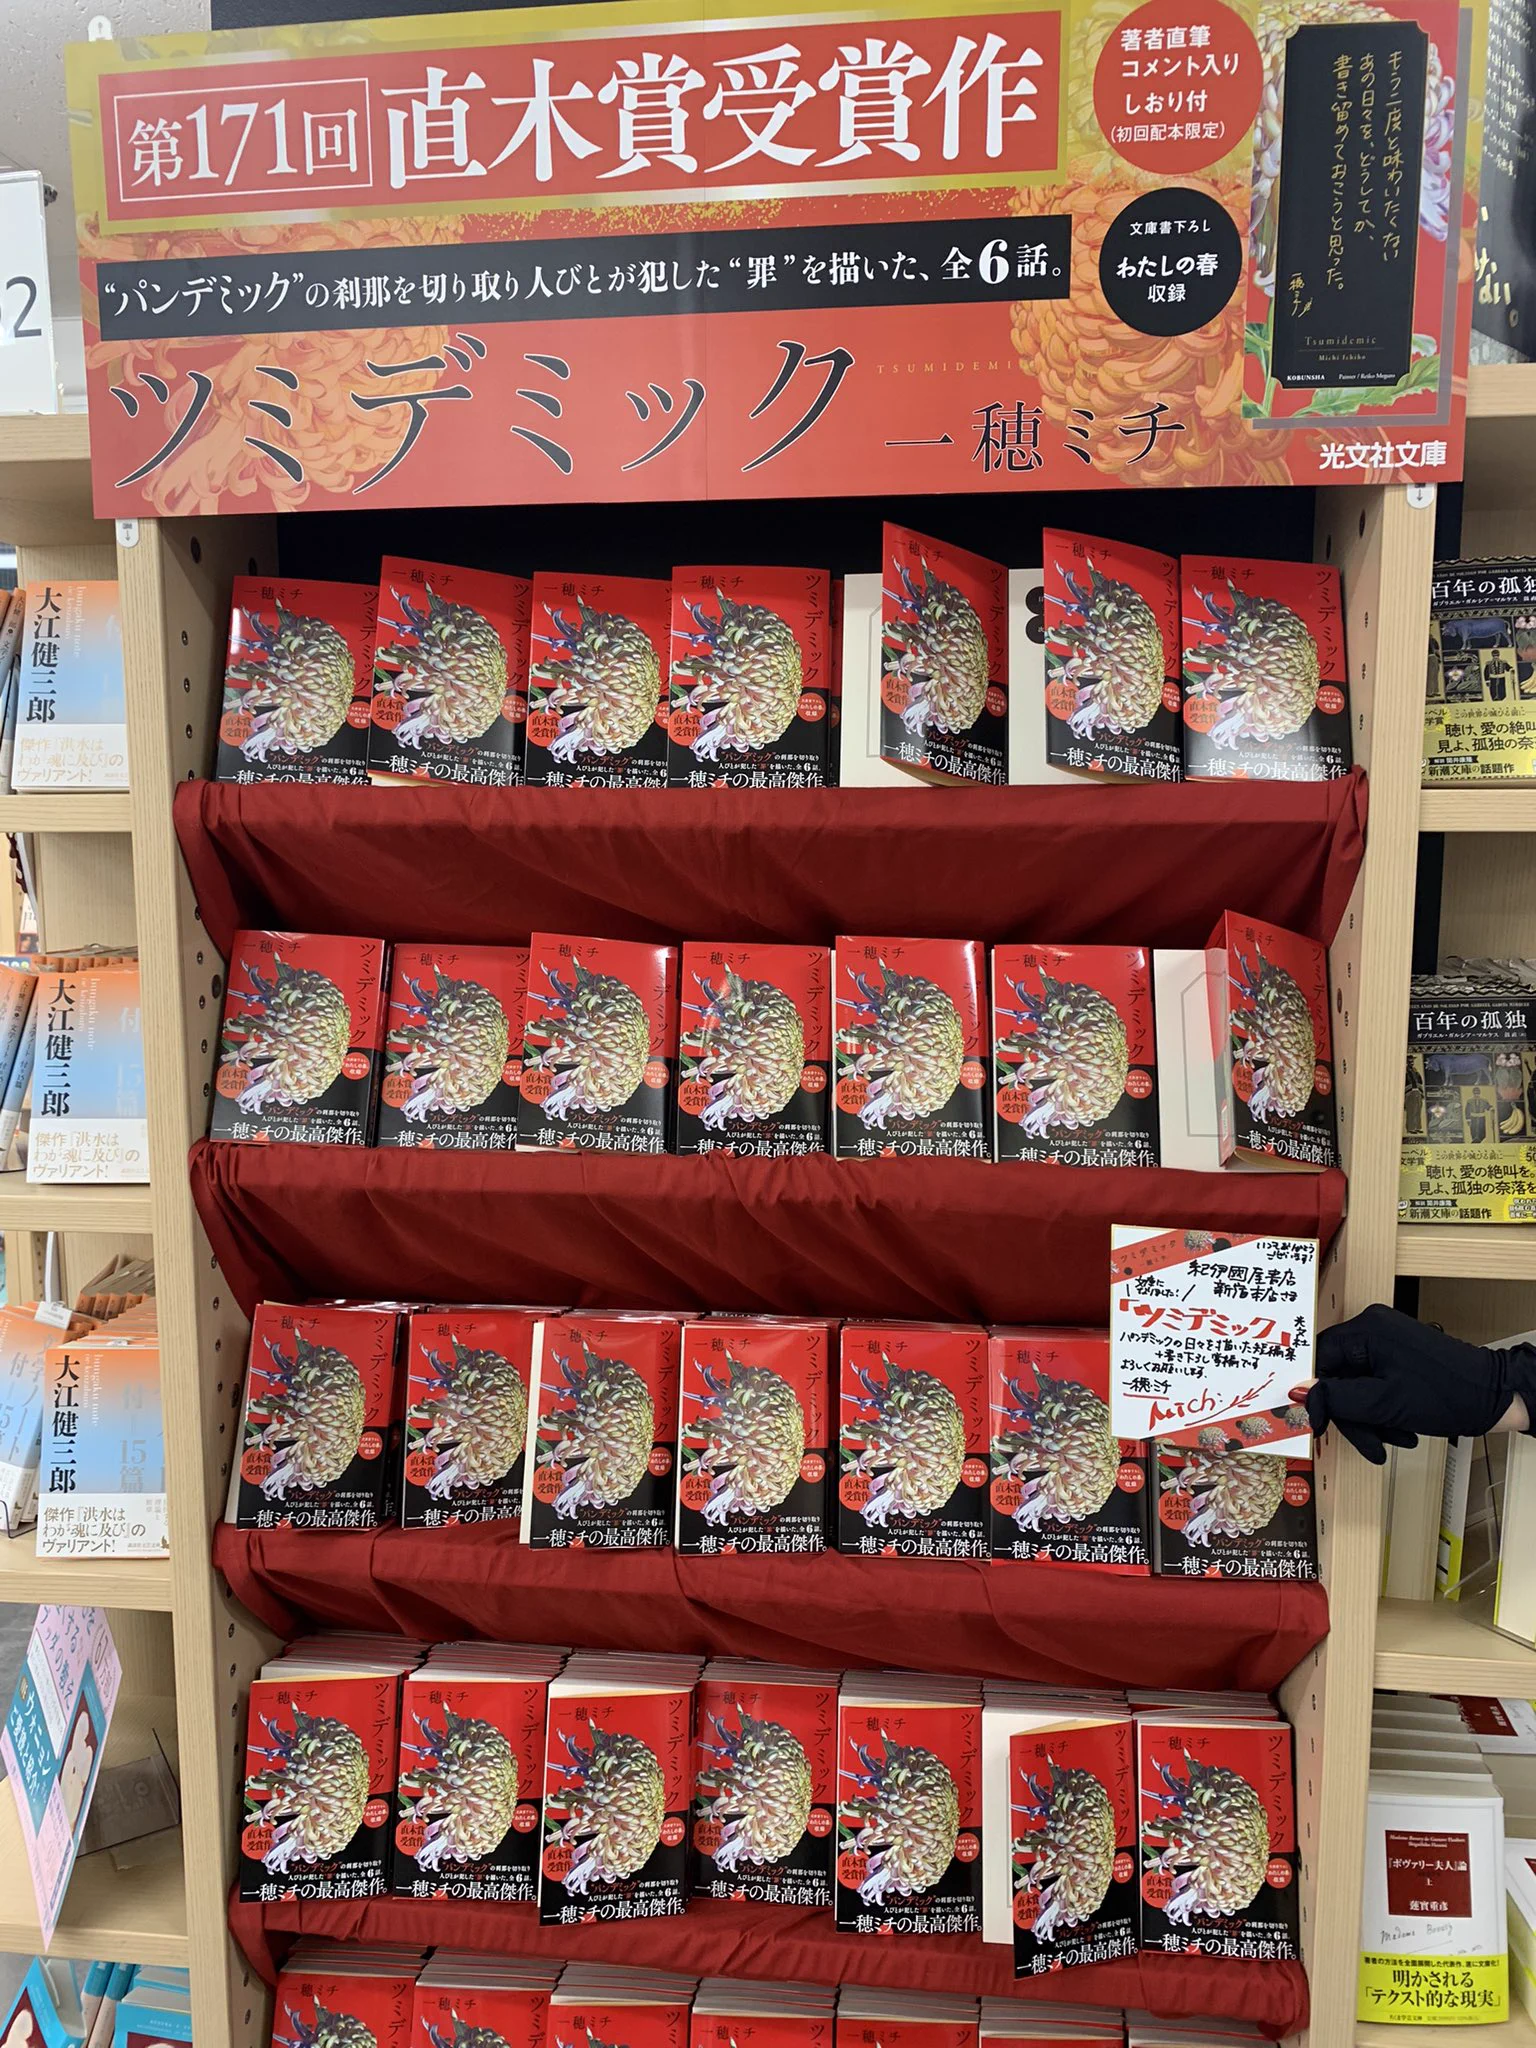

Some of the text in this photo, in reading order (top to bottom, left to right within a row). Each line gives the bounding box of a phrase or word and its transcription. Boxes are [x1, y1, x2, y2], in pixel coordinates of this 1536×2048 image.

[1120, 26, 1211, 51] 著者直筆
[1121, 53, 1240, 79] コメント入り
[380, 31, 1044, 189] 直木賞受賞作
[1124, 91, 1208, 115] しおり付
[1109, 120, 1227, 143] (初回配本限定)
[127, 99, 358, 189] 第171回
[1129, 218, 1212, 236] 文庫書下ろし
[1116, 253, 1219, 279] わたしの春
[1147, 284, 1186, 305] 収録
[1304, 336, 1377, 346] Tsumidemic
[877, 361, 1026, 374] TSUMIDEMI
[109, 333, 855, 494] ツミデミック
[885, 401, 1186, 473] 一穂ミチ
[1319, 441, 1448, 469] 光文社文庫
[684, 575, 743, 587] 一穂ミチ
[1193, 565, 1254, 579] 一穂ミチ
[544, 582, 603, 596] 一穂ミチ
[804, 575, 822, 683] ツミデミック
[1315, 571, 1335, 676] ツミデミック
[26, 587, 63, 724] 大江健三郎
[1437, 736, 1536, 754] 見よ、孤独の奈
[243, 941, 301, 954] 一穂ミチ
[542, 944, 598, 957] 一穂ミチ
[847, 946, 904, 959] 一穂ミチ
[1005, 954, 1065, 967] 一穂ミチ
[351, 943, 376, 1044] ツミデミック
[1413, 1010, 1527, 1031] 百年の孤独
[41, 978, 77, 1117] 大江健三郎
[213, 1123, 365, 1145] 一穂ミチの最高傑作。
[840, 1139, 992, 1158] 一穂ミチの最高傑作。
[265, 1316, 320, 1329] 一穂ミチ
[421, 1324, 476, 1336] 一穂ミチ
[850, 1340, 908, 1353] 一穂ミチ
[366, 1318, 390, 1423] ツミデミック
[656, 1330, 675, 1439] ツミデミック
[806, 1336, 823, 1445] ツミデミック
[965, 1340, 982, 1449] ツミデミック
[48, 1355, 80, 1494] 大江健三郎
[42, 1538, 116, 1554] ヴァリアント!
[533, 1528, 670, 1547] 一穂ミチの最高傑作。
[682, 1534, 827, 1553] 一穂ミチの最高傑作。
[842, 1537, 991, 1558] 一穂ミチの最高傑作。
[995, 1543, 1149, 1565] 一穂ミチの最高傑作。
[1164, 1556, 1317, 1579] 一穂ミチの最高傑作。
[559, 1707, 614, 1720] 一穂ミチ
[850, 1717, 906, 1731] 一穂ミチ
[371, 1683, 390, 1790] ツミデミック
[519, 1688, 539, 1793] ツミデミック
[813, 1692, 831, 1798] ツミデミック
[1152, 1736, 1209, 1750] 一穂ミチ
[666, 1699, 684, 1809] ツミデミック
[960, 1713, 978, 1823] ツミデミック
[1115, 1730, 1129, 1844] ツミデミック
[1267, 1735, 1288, 1848] ツミデミック
[242, 1877, 387, 1901] 一穂ミチの最高傑作。
[396, 1881, 536, 1901] 一穂ミチの最高傑作。
[695, 1882, 833, 1906] 一穂ミチの最高傑作。
[543, 1899, 685, 1923] 一穂ミチの最高傑作。
[839, 1914, 981, 1933] 一穂ミチの最高傑作。
[1145, 1938, 1296, 1960] 一穂ミチの最高傑作。
[1392, 1969, 1475, 1988] 明かされる
[1365, 1988, 1502, 2009] 「テクスト的な現実」
